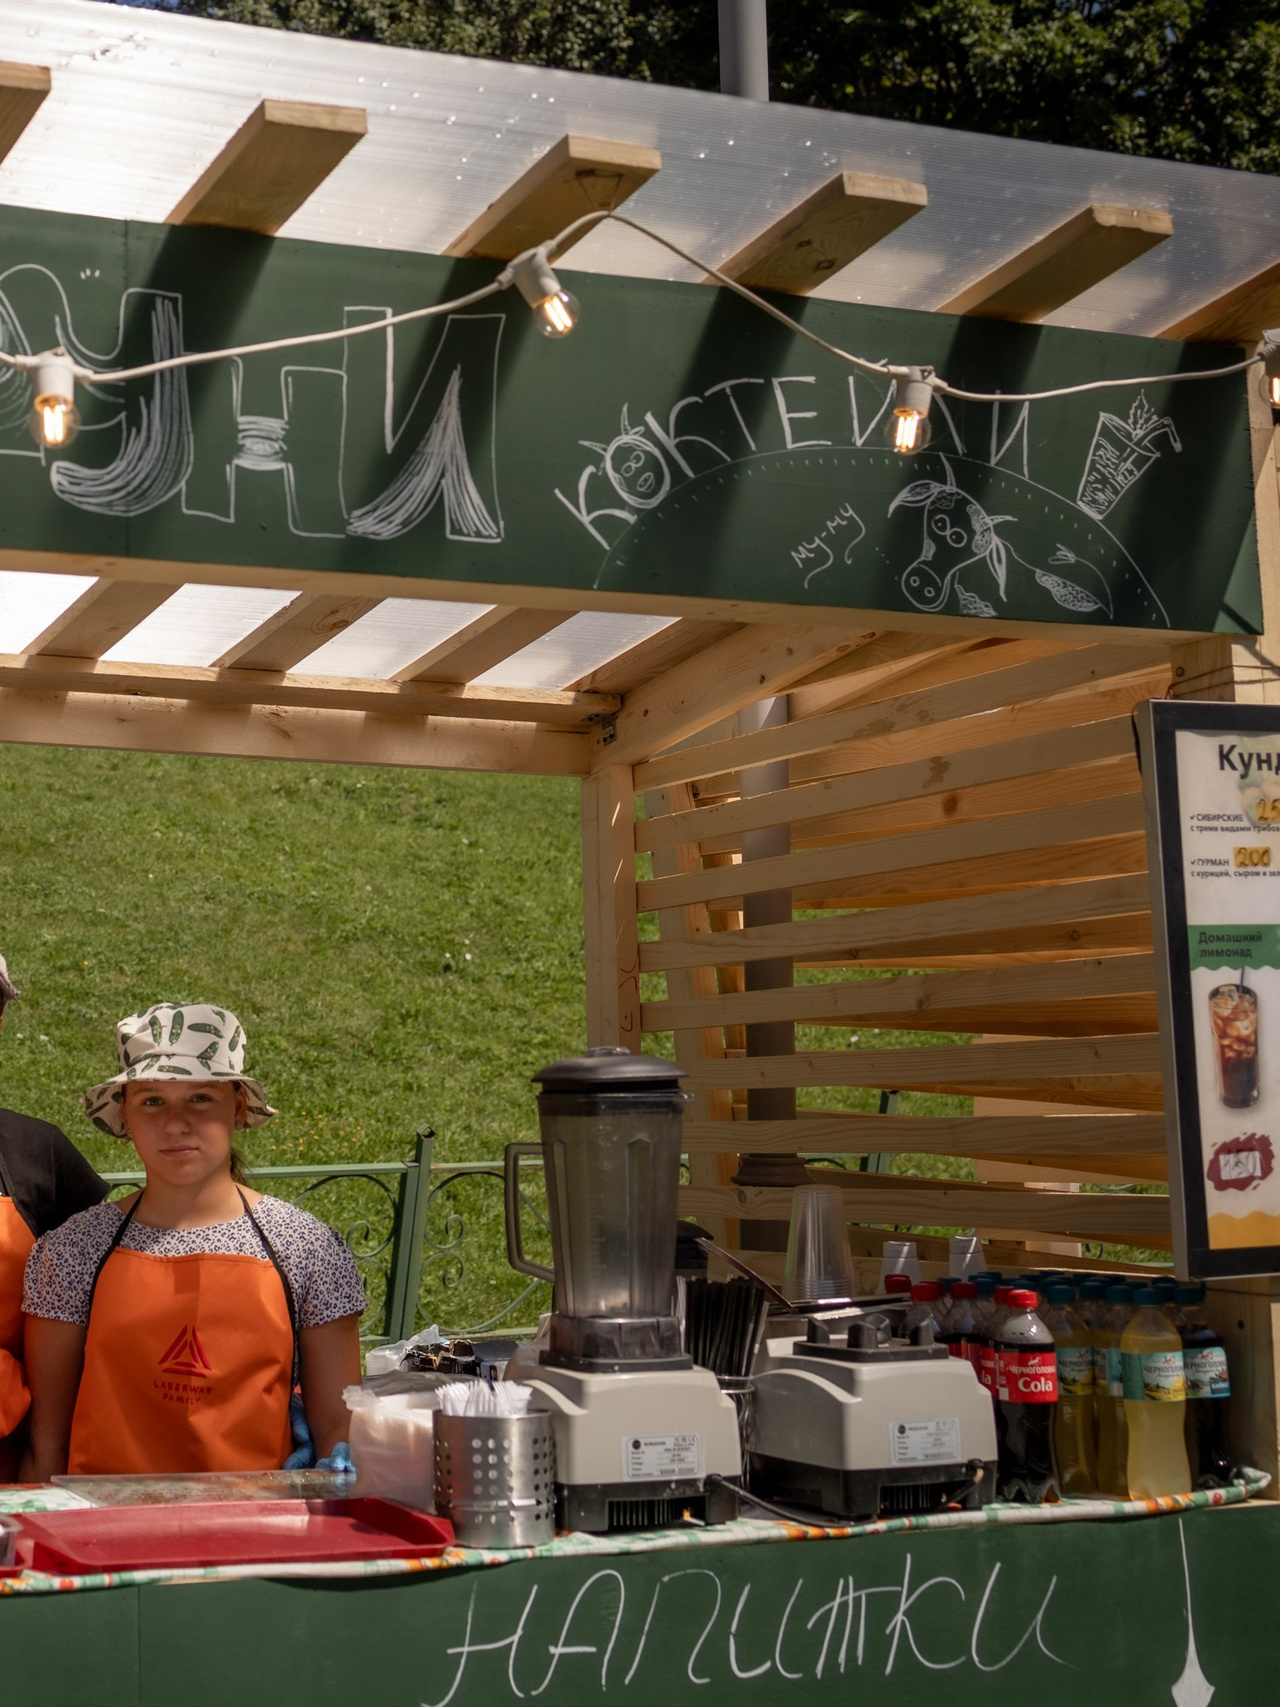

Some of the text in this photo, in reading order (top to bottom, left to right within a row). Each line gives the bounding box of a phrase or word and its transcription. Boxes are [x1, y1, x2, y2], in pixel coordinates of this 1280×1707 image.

[1196, 813, 1244, 822] СИБИРСКИЕ
[1197, 858, 1229, 867] ГУРМАН
[1238, 847, 1270, 868] 200
[1199, 931, 1262, 945] Домашний
[1200, 948, 1252, 958] лимонад
[154, 1380, 212, 1395] LASERWAR
[1017, 1377, 1053, 1392] Cola
[163, 1393, 200, 1405] FAMILY
